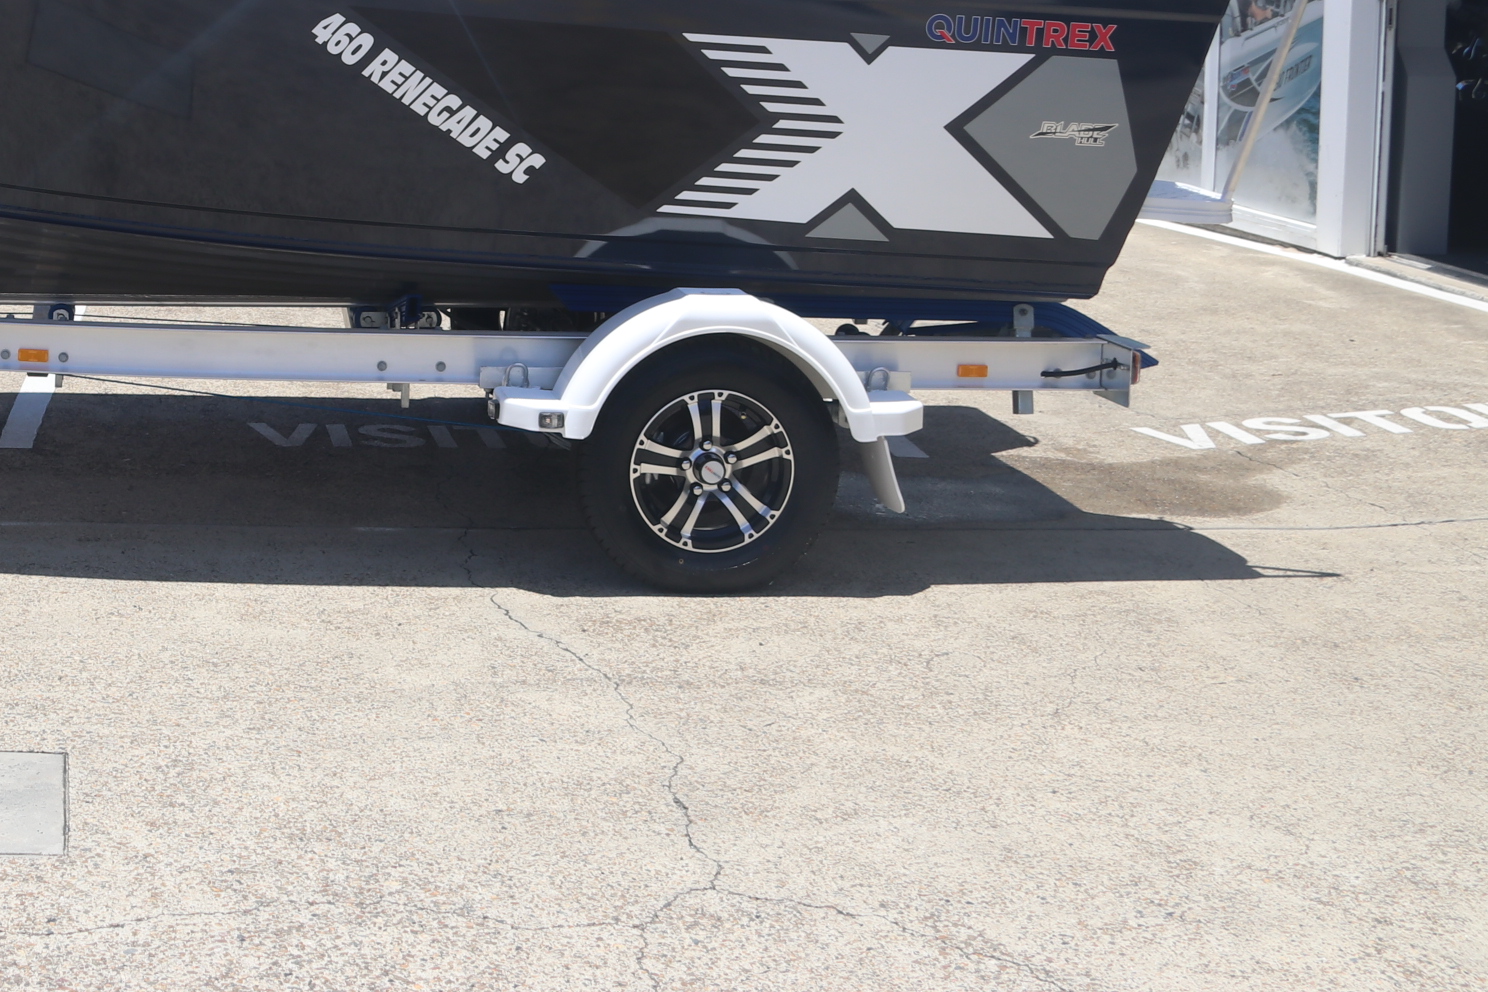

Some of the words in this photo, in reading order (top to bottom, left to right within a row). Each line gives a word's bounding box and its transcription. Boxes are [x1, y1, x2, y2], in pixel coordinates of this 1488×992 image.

[925, 13, 1118, 52] QUINTREX
[311, 12, 375, 66] 460
[361, 47, 511, 160] RENEGADE
[493, 141, 547, 184] SC
